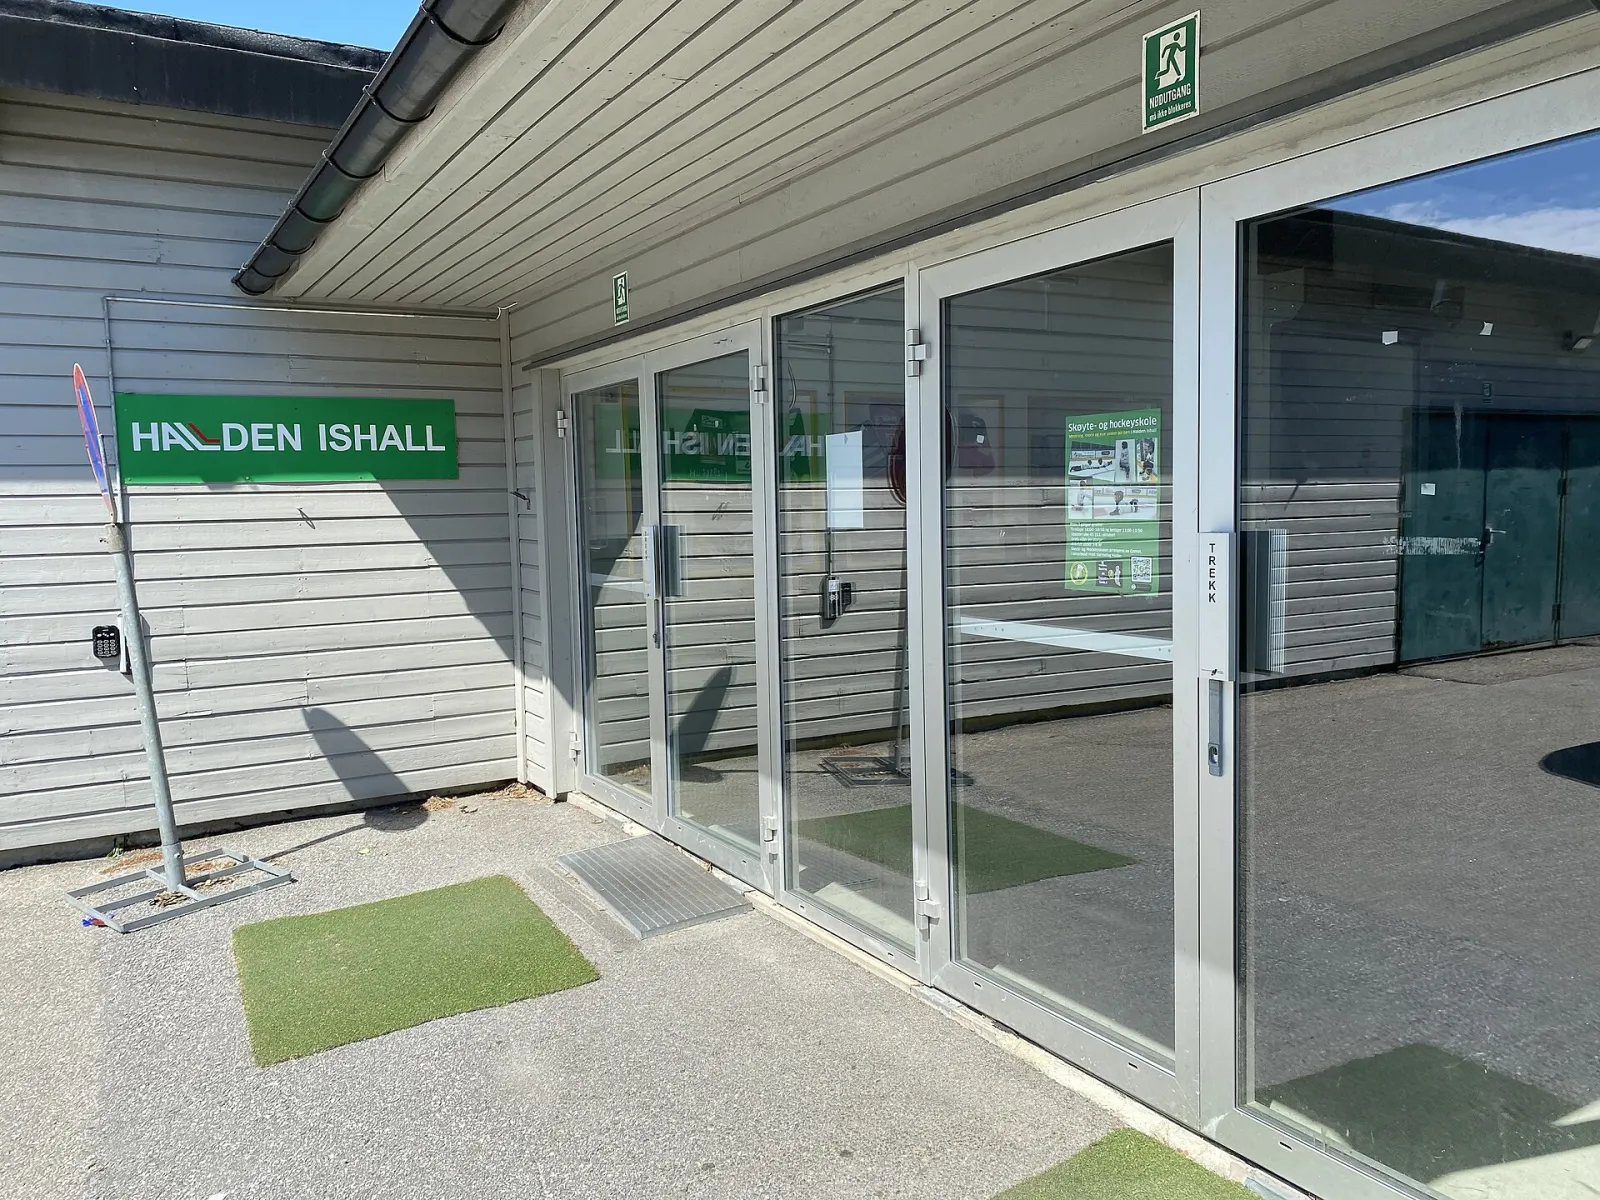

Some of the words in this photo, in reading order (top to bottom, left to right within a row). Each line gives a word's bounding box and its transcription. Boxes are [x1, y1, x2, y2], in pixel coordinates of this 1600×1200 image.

[1149, 83, 1192, 109] NØDUTGANG
[1168, 101, 1192, 115] blokkeres
[132, 421, 302, 452] HALDEN
[319, 423, 446, 452] ISHALL
[1068, 422, 1097, 433] Skøyte-
[1098, 420, 1108, 431] og
[1109, 415, 1157, 429] hockeyskole
[1208, 543, 1216, 603] TREKK
